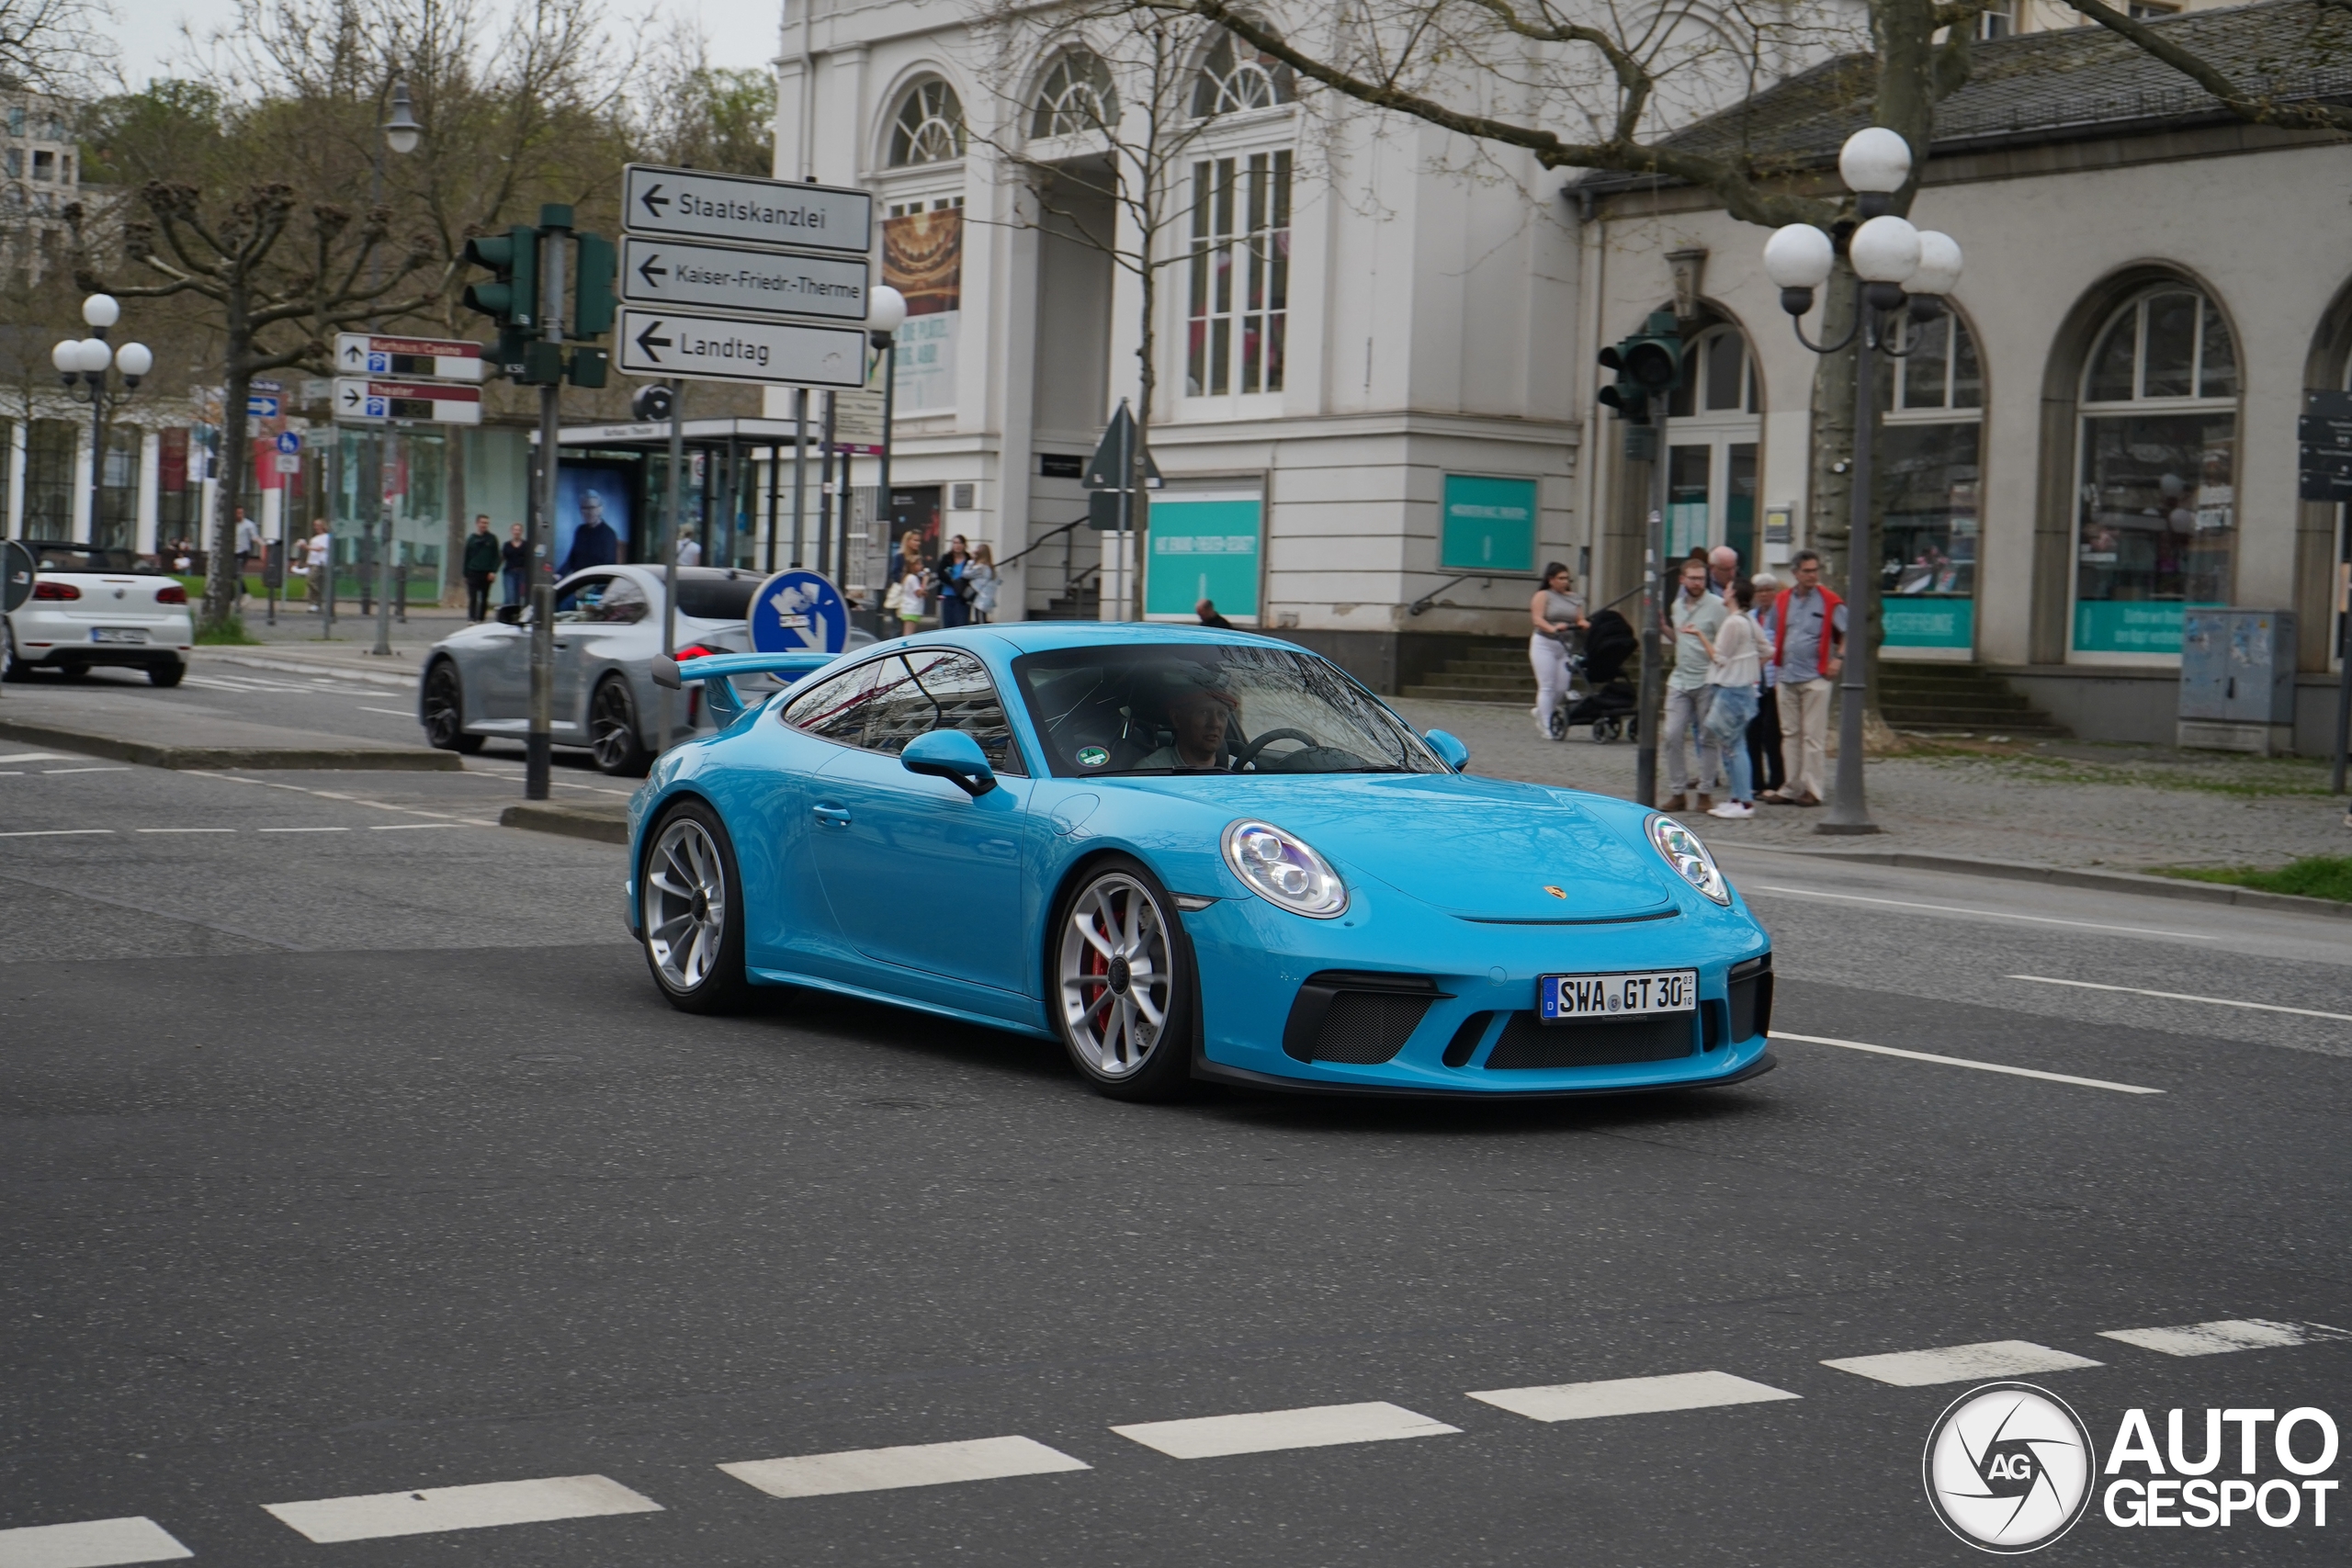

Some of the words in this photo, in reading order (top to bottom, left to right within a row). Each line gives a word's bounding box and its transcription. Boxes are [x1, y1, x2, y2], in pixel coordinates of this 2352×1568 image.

[679, 193, 826, 229] Staatskanzlei
[675, 264, 860, 299] Kaiser-Friedr.-Therme
[681, 333, 770, 367] Landtag
[370, 383, 414, 396] Theater
[1547, 1001, 1554, 1010] D
[1560, 981, 1605, 1012] SWA
[1623, 979, 1651, 1010] GT
[1657, 976, 1681, 1008] 30
[1683, 976, 1692, 984] 03
[1683, 997, 1692, 1006] 10
